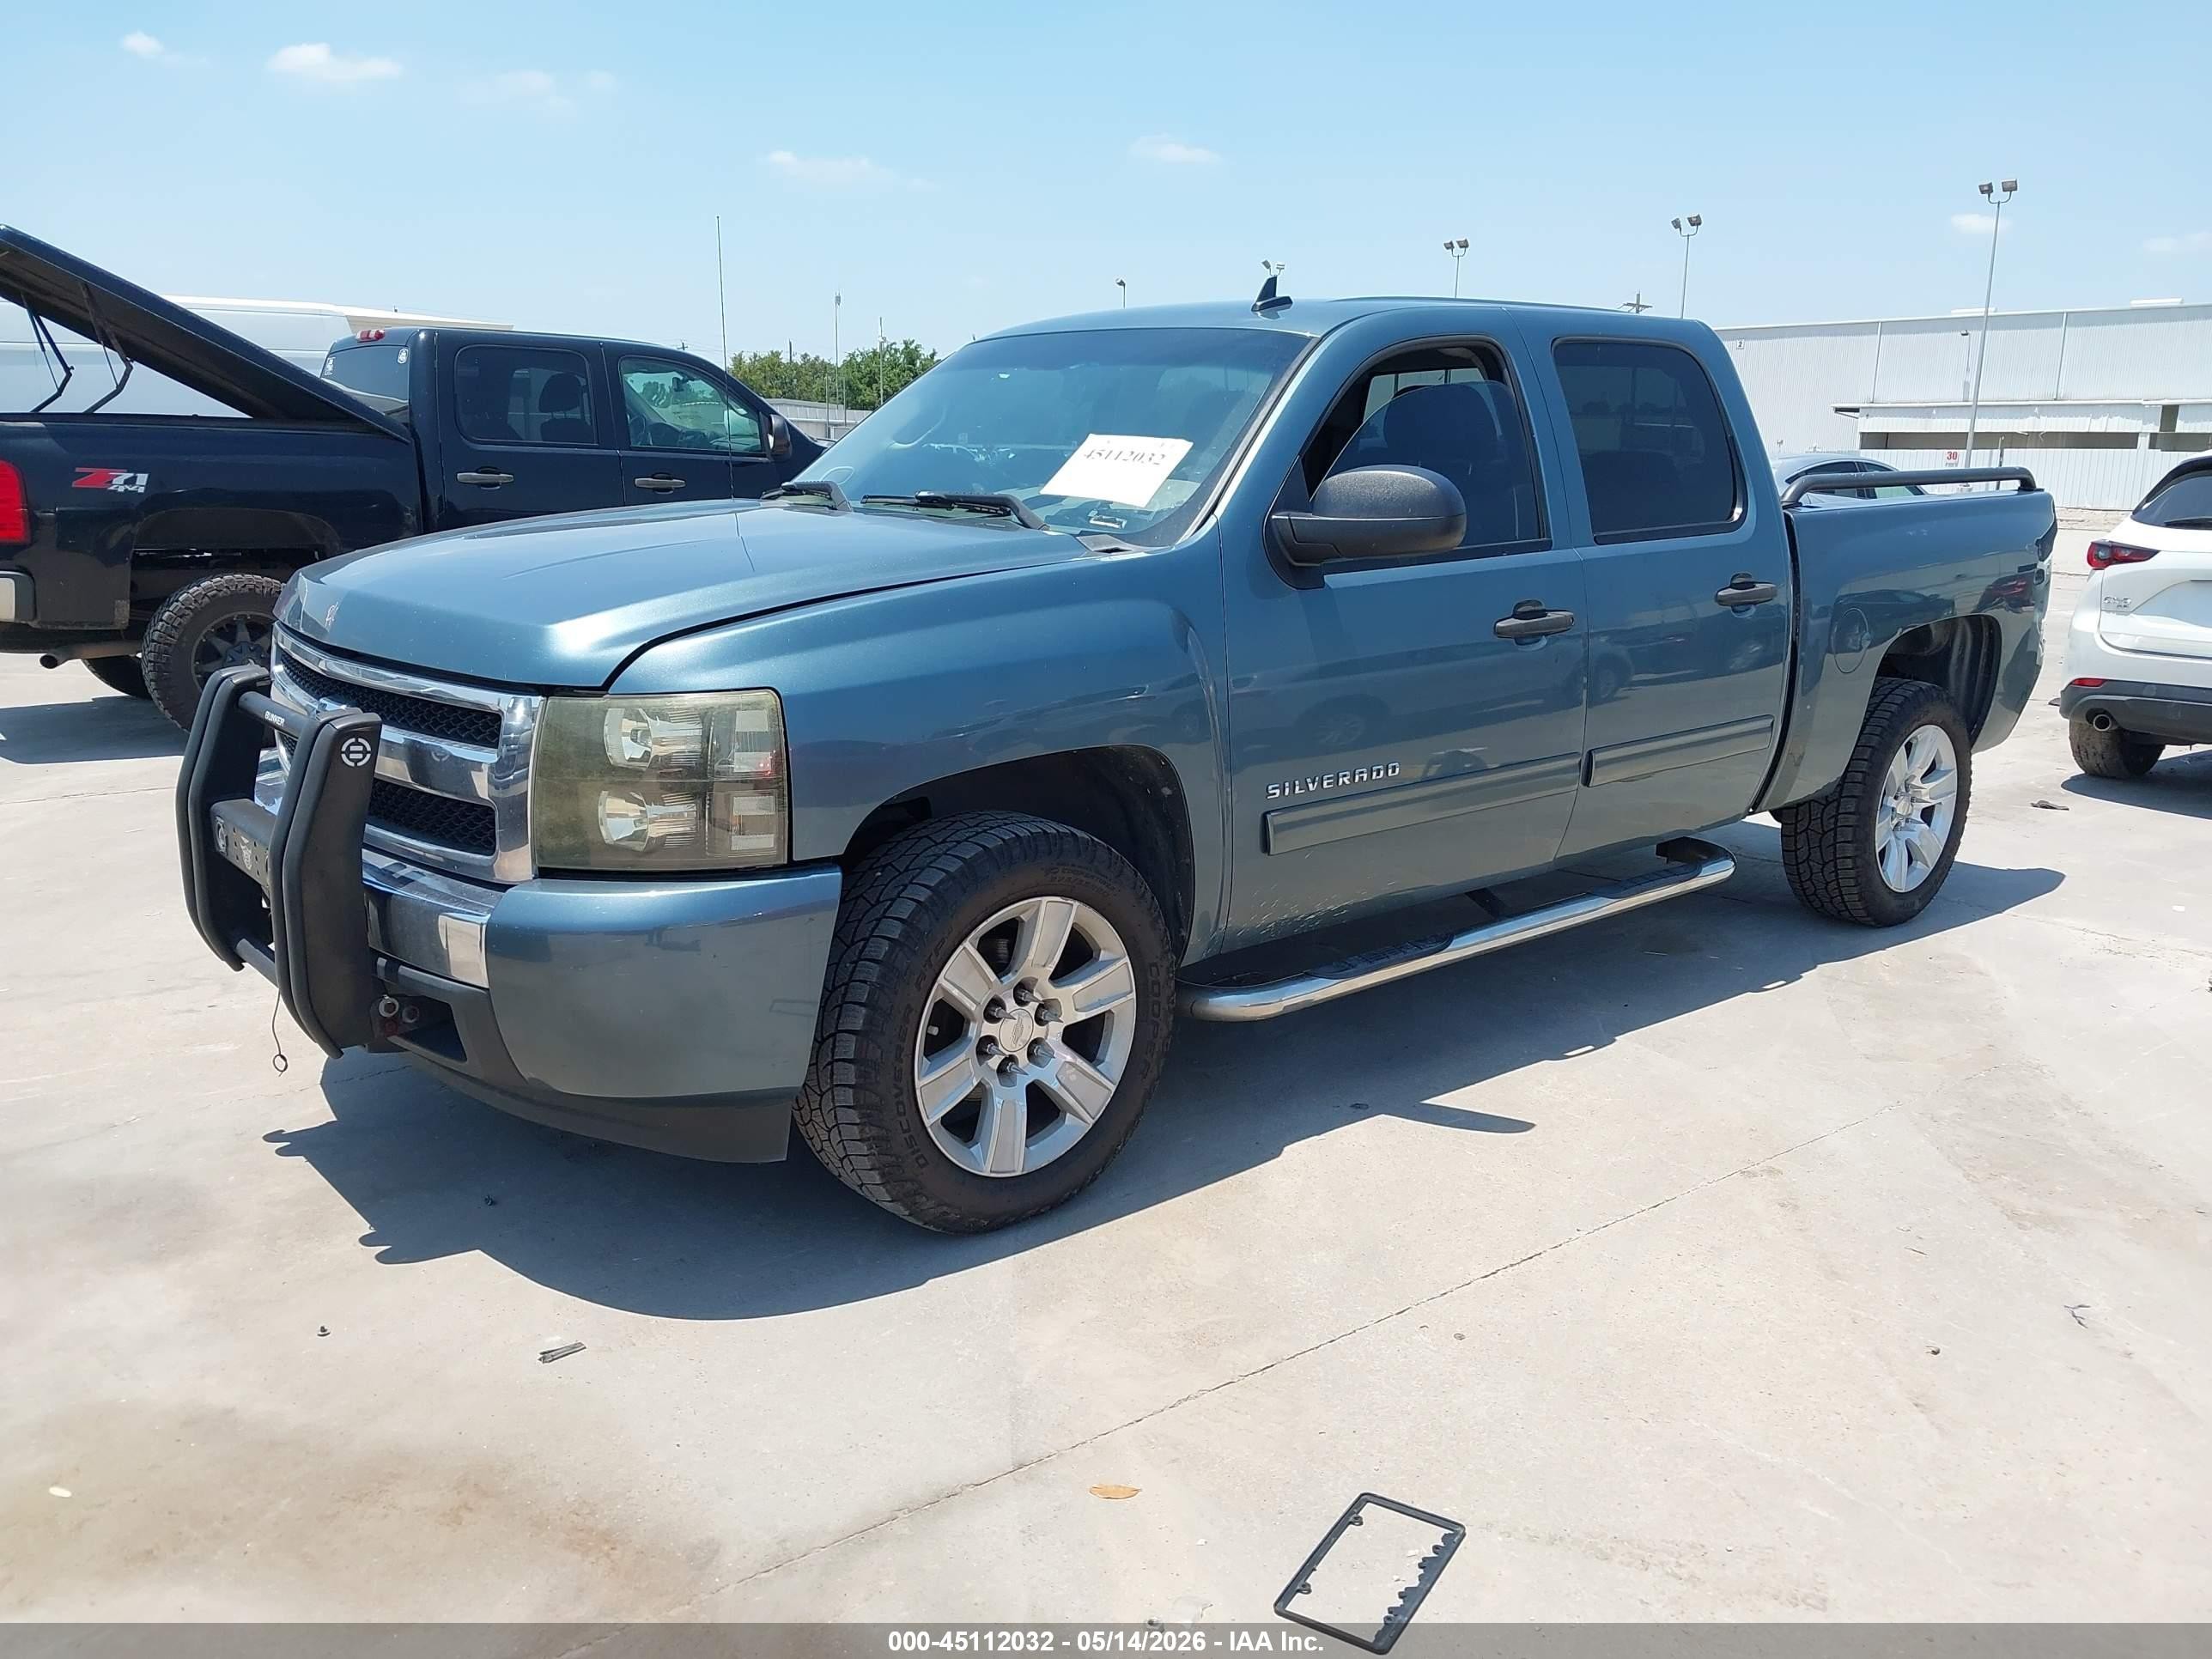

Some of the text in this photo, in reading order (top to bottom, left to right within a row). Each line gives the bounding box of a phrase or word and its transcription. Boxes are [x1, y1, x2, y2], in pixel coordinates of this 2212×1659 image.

[1084, 449, 1166, 465] 45112032
[1947, 451, 1958, 461] 30
[71, 467, 149, 488] Z71
[264, 710, 285, 727] BUNKER
[1267, 761, 1401, 799] SILVERADO
[1141, 962, 1161, 1080] COOPER
[893, 1003, 929, 1168] DISCOVERER
